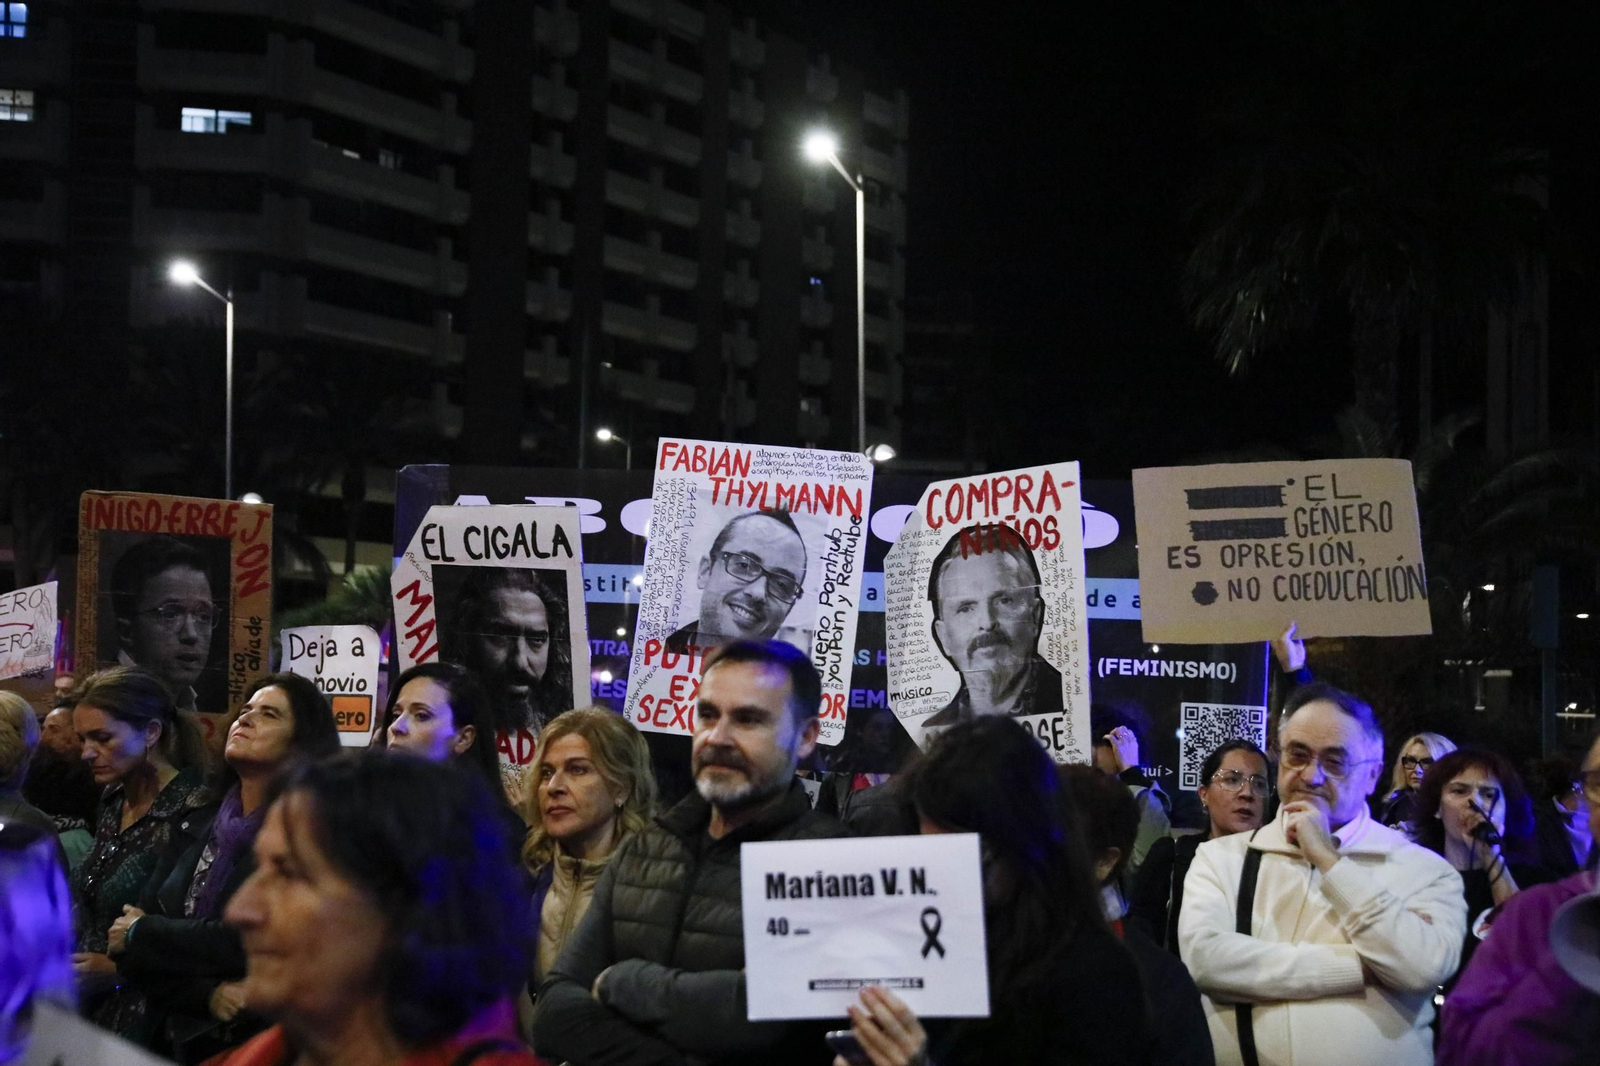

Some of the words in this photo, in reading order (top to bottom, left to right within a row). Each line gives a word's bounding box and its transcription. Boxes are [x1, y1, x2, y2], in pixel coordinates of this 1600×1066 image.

[708, 476, 862, 521] THYLMANN
[926, 469, 1075, 530] COMPRA-
[1304, 473, 1362, 500] EL
[1293, 500, 1393, 538] GÉNERO
[421, 523, 455, 562] EL
[463, 520, 573, 560] CIGALA
[960, 514, 1060, 561] NIÑOS
[1167, 545, 1202, 569] ES
[1220, 536, 1366, 570] OPRESIÓN,
[1227, 577, 1261, 602] NO
[1273, 555, 1428, 603] COEDUCACIÓN
[0, 588, 43, 615] ERO
[838, 594, 853, 608] y
[0, 632, 33, 653] ERO
[289, 633, 338, 675] Deja
[351, 637, 365, 657] a
[644, 638, 710, 676] PUT
[590, 639, 630, 656] TRA
[1097, 657, 1237, 683] (FEMINISMO)
[669, 675, 701, 702] EX
[889, 685, 933, 702] músico
[334, 711, 365, 726] ero
[637, 693, 695, 734] SEX
[1140, 764, 1163, 778] quí
[764, 870, 875, 900] Mariana
[880, 868, 903, 896] V.
[766, 917, 789, 936] 40
